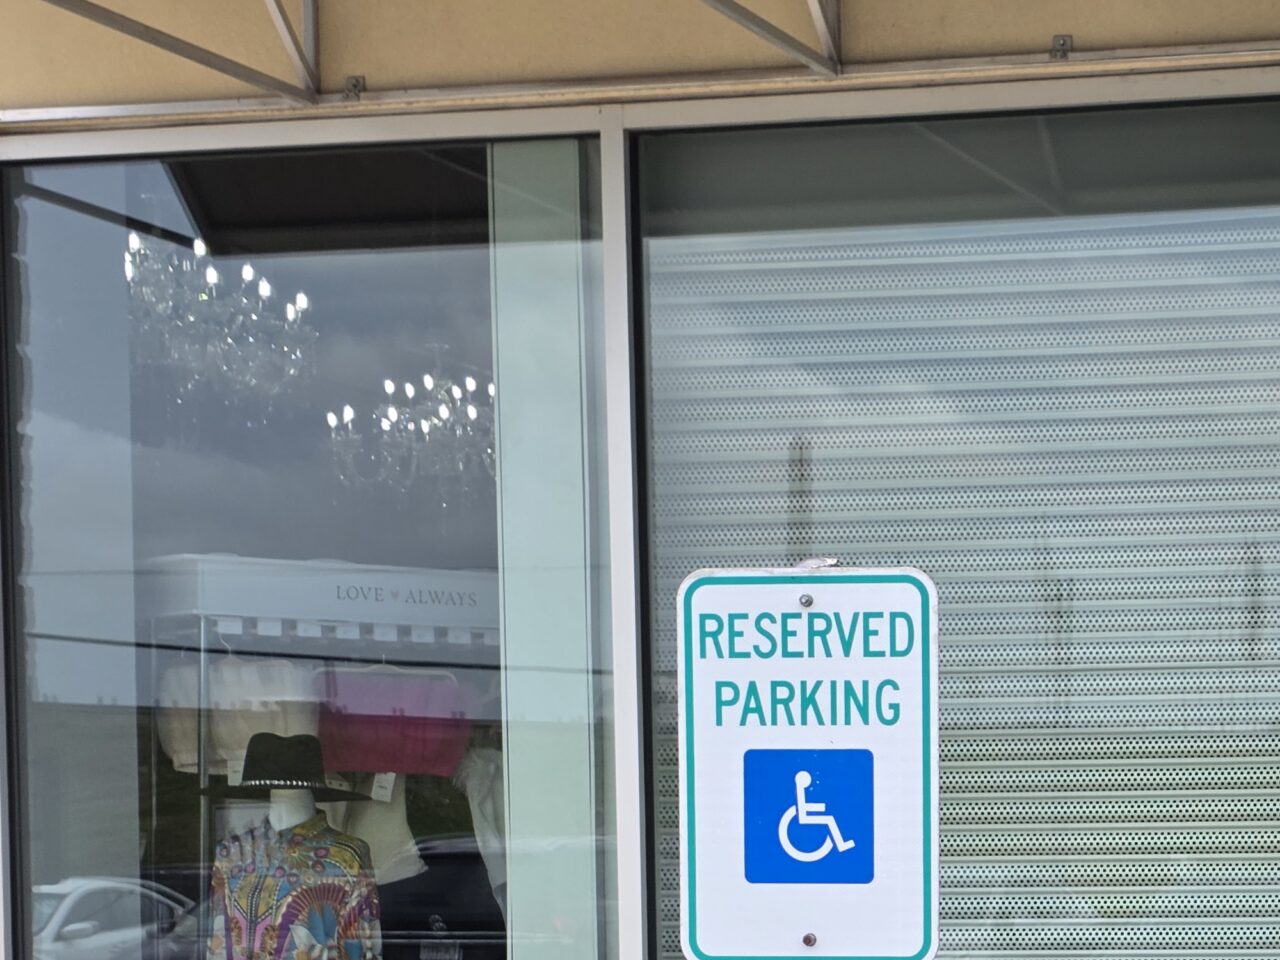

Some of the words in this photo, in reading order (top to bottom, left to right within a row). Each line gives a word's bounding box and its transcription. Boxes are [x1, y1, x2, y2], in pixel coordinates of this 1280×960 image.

[336, 585, 385, 602] LOVE
[405, 589, 478, 607] ALWAYS
[699, 611, 915, 659] RESERVED
[715, 679, 901, 727] PARKING
